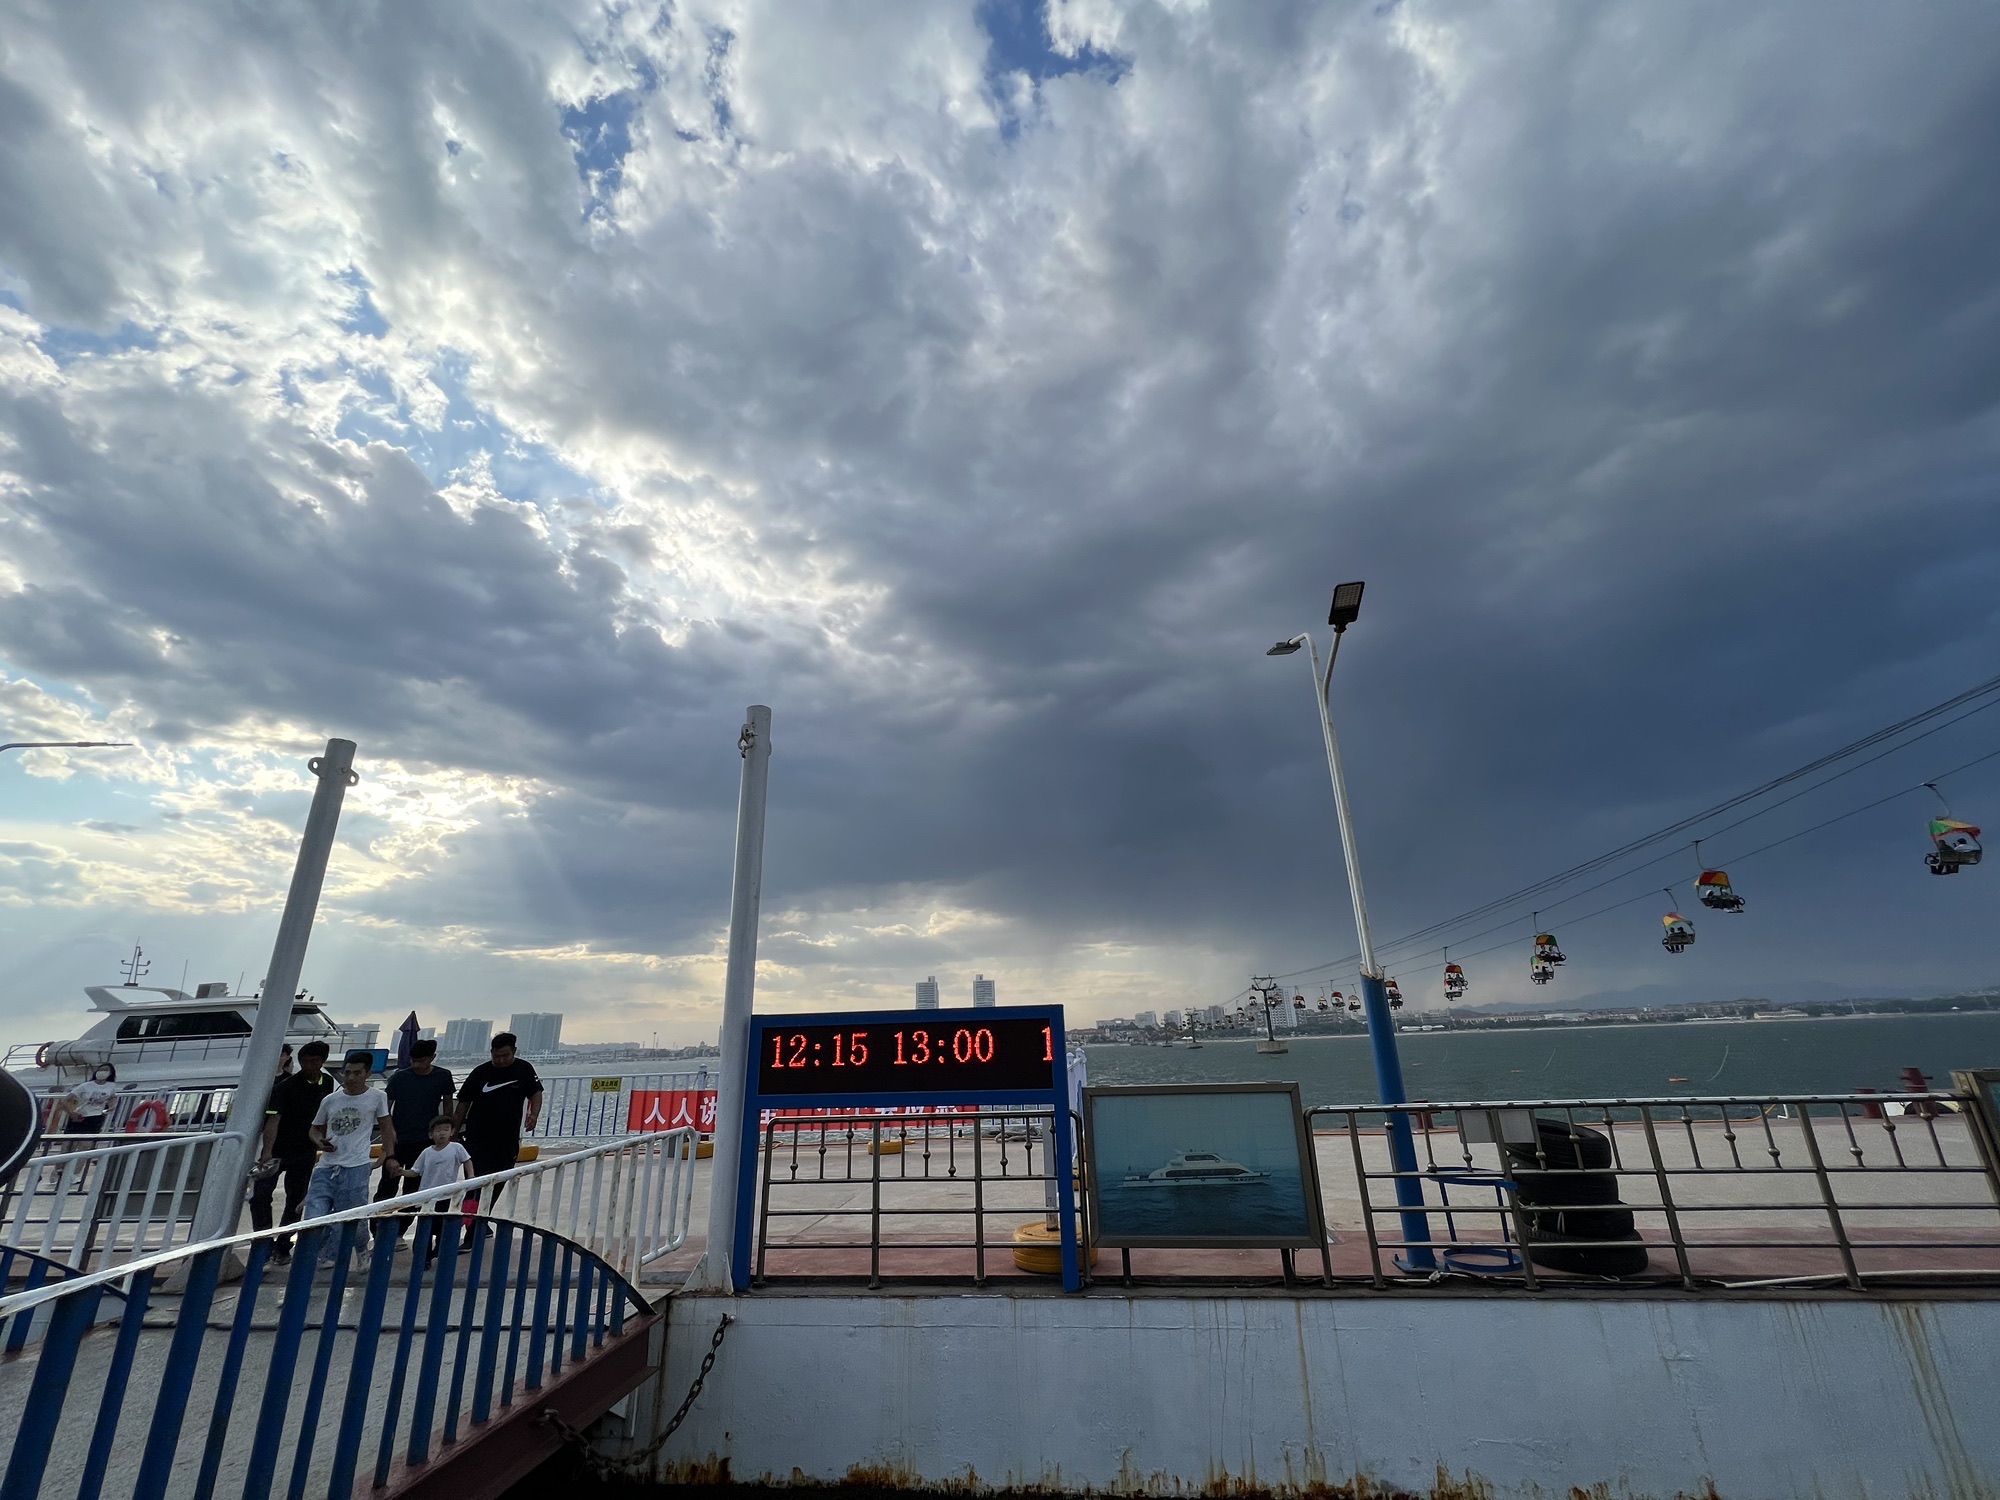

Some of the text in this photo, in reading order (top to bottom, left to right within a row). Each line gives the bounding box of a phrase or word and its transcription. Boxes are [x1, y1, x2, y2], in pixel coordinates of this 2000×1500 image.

[771, 1025, 1054, 1068] 12:15 13:00 1
